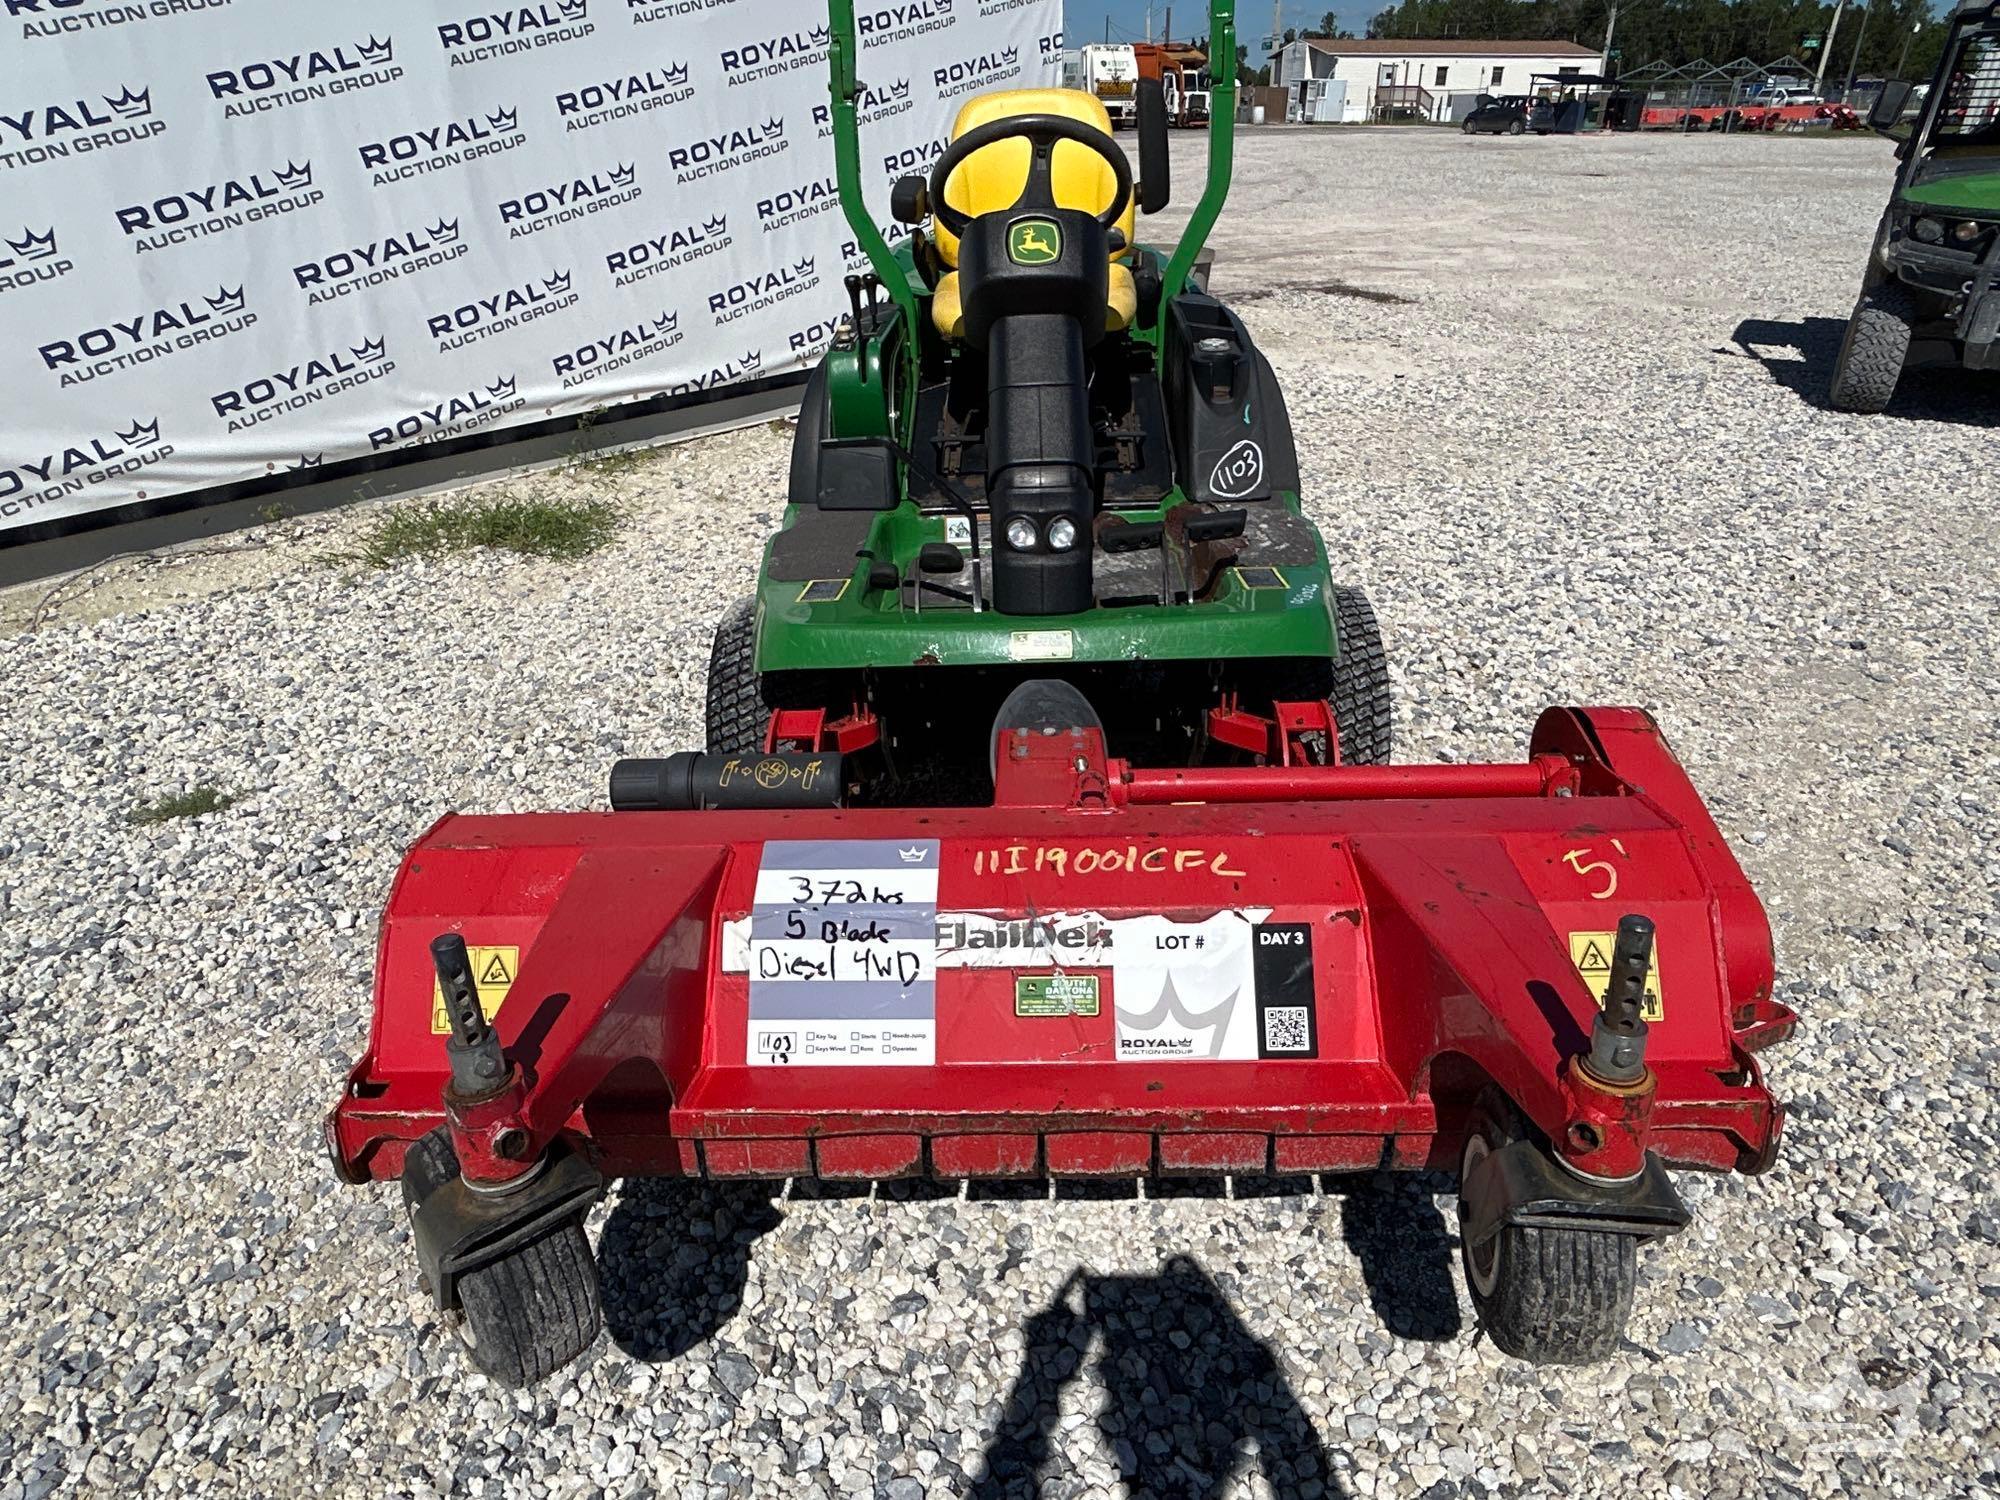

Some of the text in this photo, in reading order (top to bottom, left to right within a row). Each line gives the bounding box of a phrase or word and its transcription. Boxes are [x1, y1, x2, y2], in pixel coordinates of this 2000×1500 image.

[23, 5, 147, 39] AUCTION
[438, 4, 561, 49] ROYAL
[634, 0, 702, 24] AUCTION
[858, 1, 935, 35] ROYAL
[863, 16, 956, 50] AUCTION GROUP
[451, 23, 594, 67] AUCTION GROUP
[720, 33, 810, 72] ROYAL
[206, 47, 361, 99] ROYAL
[728, 50, 826, 87] AUCTION GROU
[934, 53, 1002, 87] ROYAL
[938, 66, 1020, 100] AUCTION GROUP
[225, 67, 403, 119] AUCTION GROUP
[556, 72, 665, 116] ROYAL
[566, 88, 694, 132] AUCTION GROUP
[812, 88, 891, 124] RAL
[873, 100, 913, 120] GROUP
[0, 100, 112, 140] YAL
[0, 120, 166, 168] TION GROUP
[358, 118, 491, 169] ROYAL
[374, 134, 526, 186] AUCTION GROUP
[669, 127, 763, 170] ROYAL
[677, 140, 788, 184] AUCTION GROUP
[115, 175, 279, 235] ROYAL
[498, 175, 611, 224] ROYAL
[510, 187, 642, 239] AUCTION GROUP
[757, 178, 839, 219] ROYAL
[763, 205, 819, 233] AUCTION
[136, 190, 324, 254] AUCTION GROUP
[841, 223, 914, 260] RAL
[293, 232, 430, 289] ROYAL
[606, 226, 705, 274] ROYAL
[616, 237, 732, 288] AUCTION GROUP
[0, 259, 74, 292] ROUP
[309, 244, 468, 306] AUCTION GROUP
[708, 268, 796, 313] ROYAL
[427, 284, 546, 338] ROYAL
[716, 277, 819, 326] AUCTION GROUP
[38, 302, 211, 370] ROYAL
[440, 294, 578, 354] AUCTION GROUP
[789, 312, 853, 351] ROYA
[61, 313, 257, 388] AUCTION GROUP
[552, 324, 656, 376] ROYAL
[564, 332, 683, 389] AUCTION GROUP
[211, 353, 356, 418] ROYAL
[228, 361, 396, 434] AUCTION GROUP
[368, 391, 491, 450] ROYAL
[465, 397, 526, 430] GROUP
[0, 444, 175, 517] CTION GROUP
[1218, 450, 1257, 490] 1103
[821, 920, 891, 943] Blade
[1156, 935, 1205, 949] LOT #
[1260, 932, 1304, 945] DAY 3
[760, 945, 920, 987] Diesel 4WD
[1121, 1039, 1177, 1047] ROYAL
